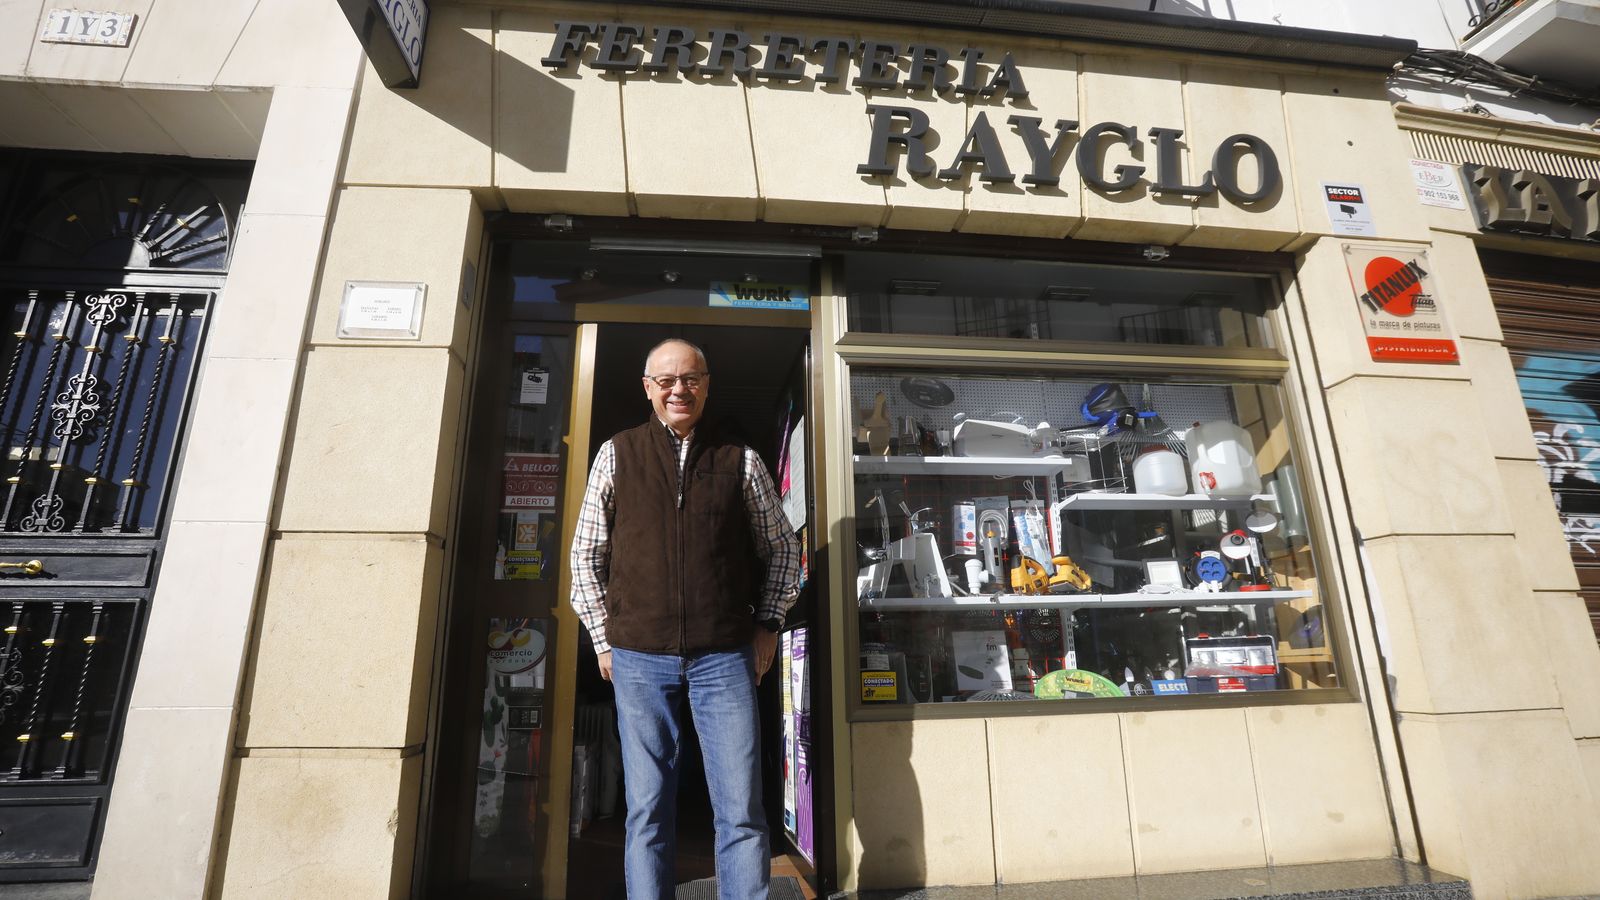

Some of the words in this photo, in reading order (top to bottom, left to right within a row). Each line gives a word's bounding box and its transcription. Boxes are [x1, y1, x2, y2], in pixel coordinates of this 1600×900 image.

[541, 20, 1029, 99] FERRETERIA
[857, 103, 1281, 201] RAYGLO
[1327, 188, 1359, 196] SECTOR
[1360, 259, 1428, 313] TITANLUX
[1379, 320, 1400, 328] marca
[1402, 320, 1411, 328] de
[1413, 320, 1441, 330] pinturas
[522, 463, 560, 472] BELLOT
[510, 497, 550, 506] ABIERTO
[490, 649, 533, 657] comercio
